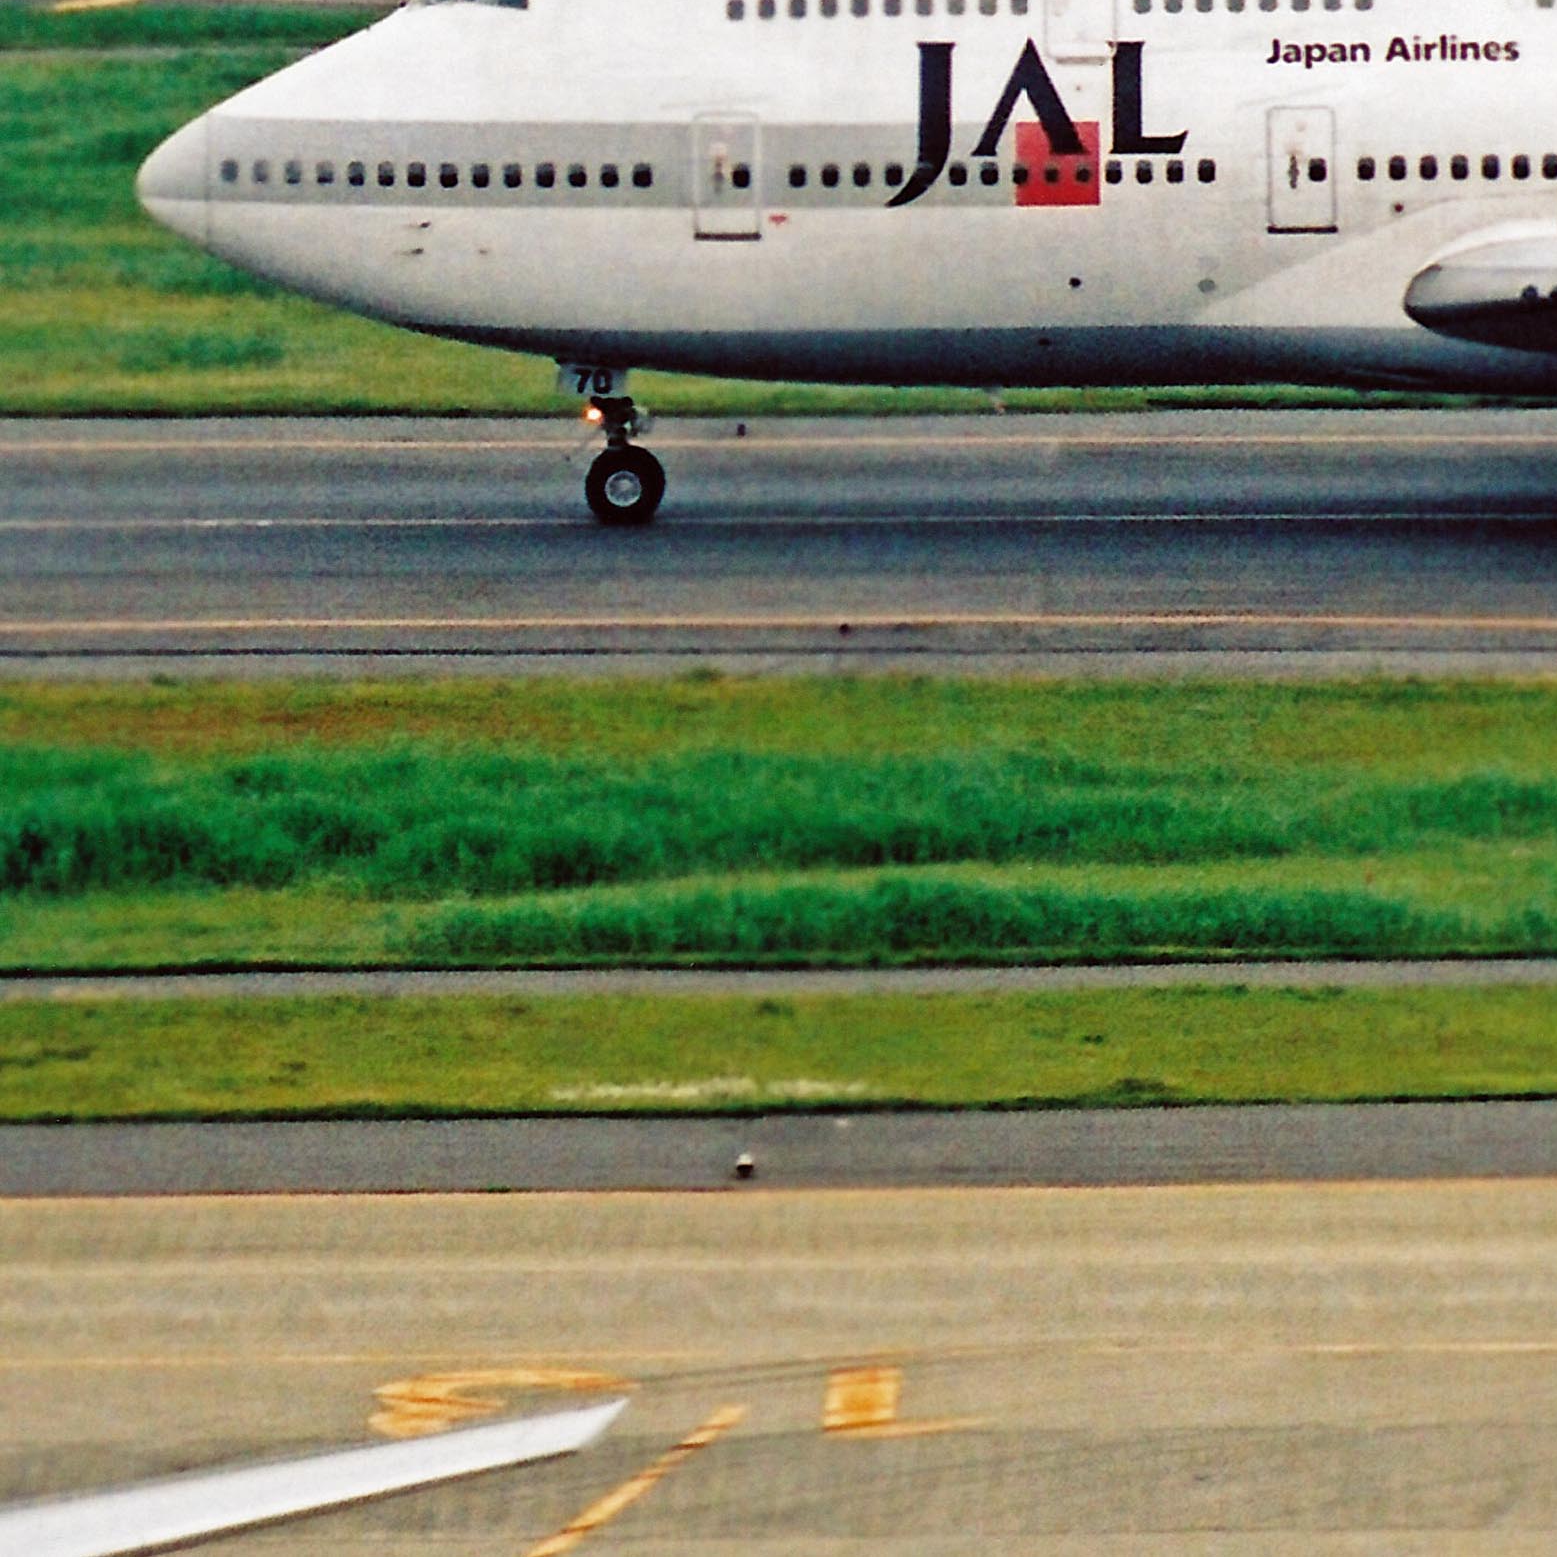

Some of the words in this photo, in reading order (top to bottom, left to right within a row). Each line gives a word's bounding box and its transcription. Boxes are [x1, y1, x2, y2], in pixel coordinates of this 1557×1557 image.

[1266, 39, 1371, 69] Japan
[1385, 34, 1520, 61] Airlines
[886, 38, 1188, 207] JAL
[574, 368, 614, 394] 70
